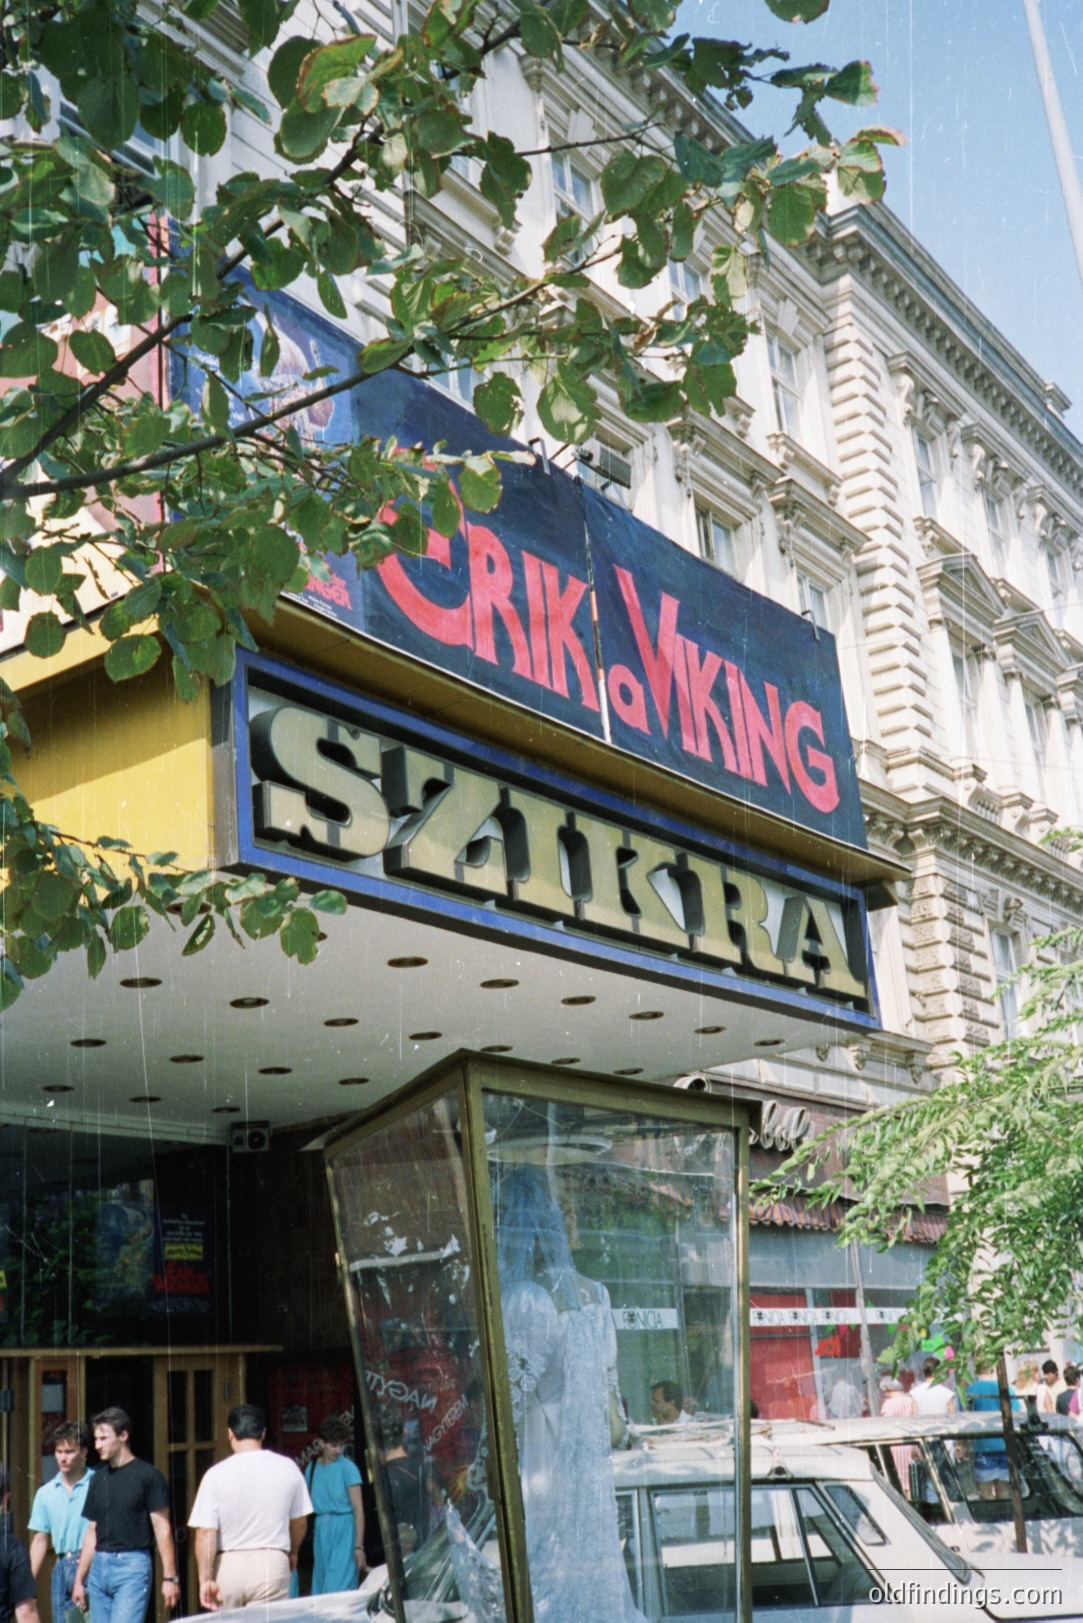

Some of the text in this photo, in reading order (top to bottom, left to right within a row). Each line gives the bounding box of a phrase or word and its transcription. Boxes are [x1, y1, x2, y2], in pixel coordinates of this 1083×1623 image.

[373, 446, 600, 712] ERIK
[613, 564, 840, 814] VIKING
[251, 705, 867, 999] SZIKRA
